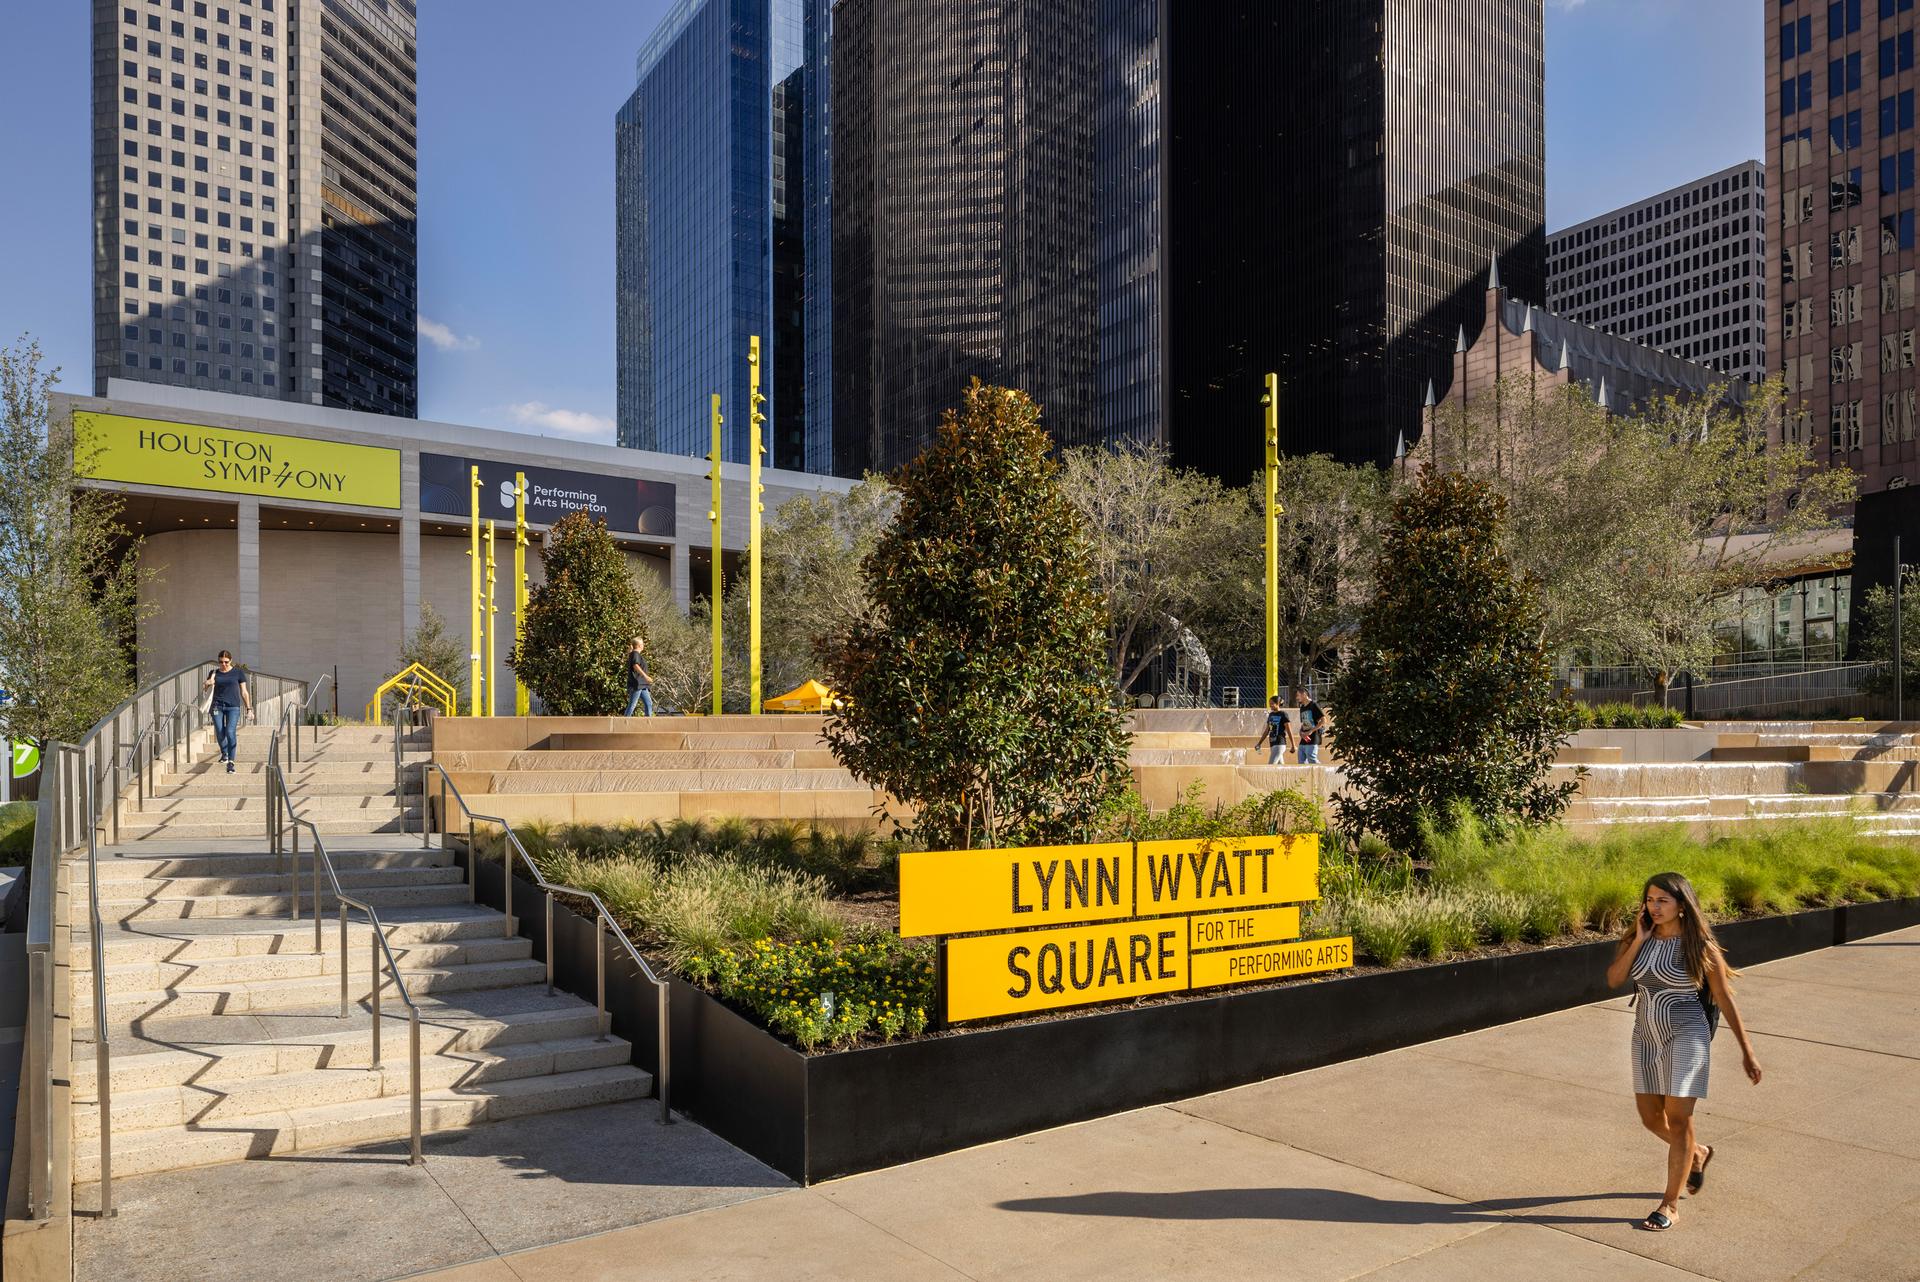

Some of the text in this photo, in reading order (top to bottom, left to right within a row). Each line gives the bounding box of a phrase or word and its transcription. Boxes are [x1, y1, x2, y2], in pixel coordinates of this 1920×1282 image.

[139, 430, 272, 463] HOUSTON
[204, 460, 346, 492] SYMPHONY
[533, 485, 597, 503] Performing
[533, 496, 557, 508] Arts
[16, 744, 34, 765] 7
[1012, 848, 1275, 914] LYNN WYATT
[1197, 918, 1255, 942] FOR THE
[1007, 931, 1177, 998] SQUARE
[1229, 944, 1348, 977] PERFORMING ARTS
